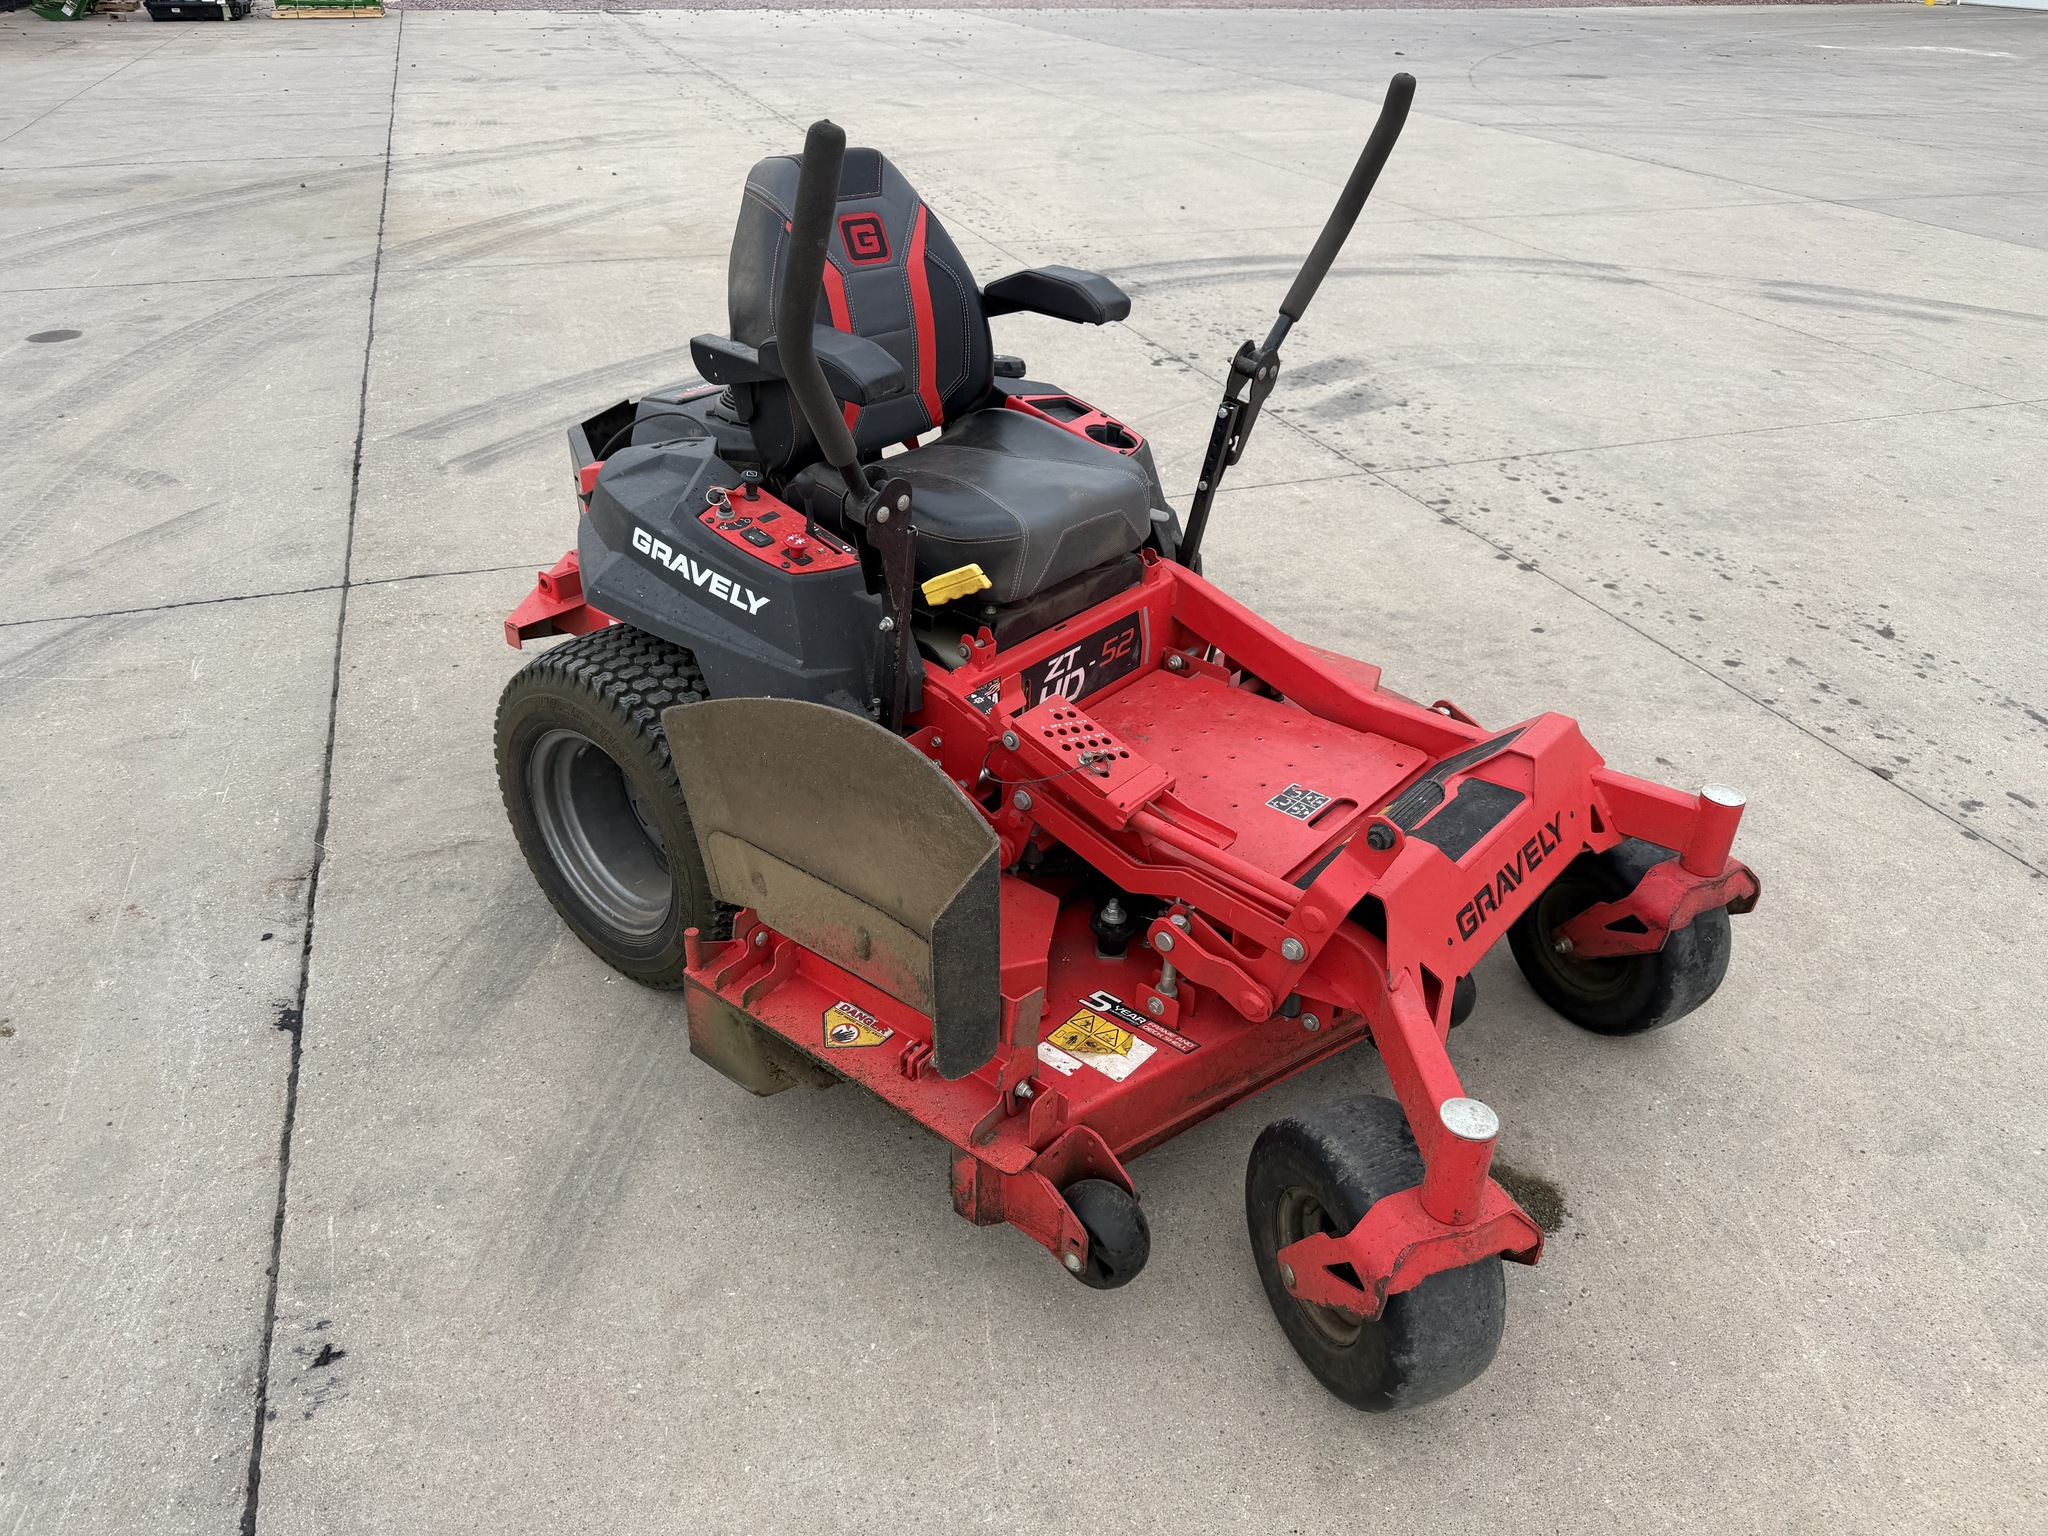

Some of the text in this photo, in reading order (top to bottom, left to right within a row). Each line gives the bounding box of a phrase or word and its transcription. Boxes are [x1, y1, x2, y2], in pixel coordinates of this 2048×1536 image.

[632, 526, 771, 616] GRAVELY
[1043, 645, 1082, 684] ZT
[1455, 810, 1563, 942] GRAVELY
[1078, 990, 1123, 1013] 5
[1114, 1005, 1147, 1024] YEAR
[1147, 1022, 1194, 1048] FRAME AND
[1161, 1035, 1187, 1051] SHELL
